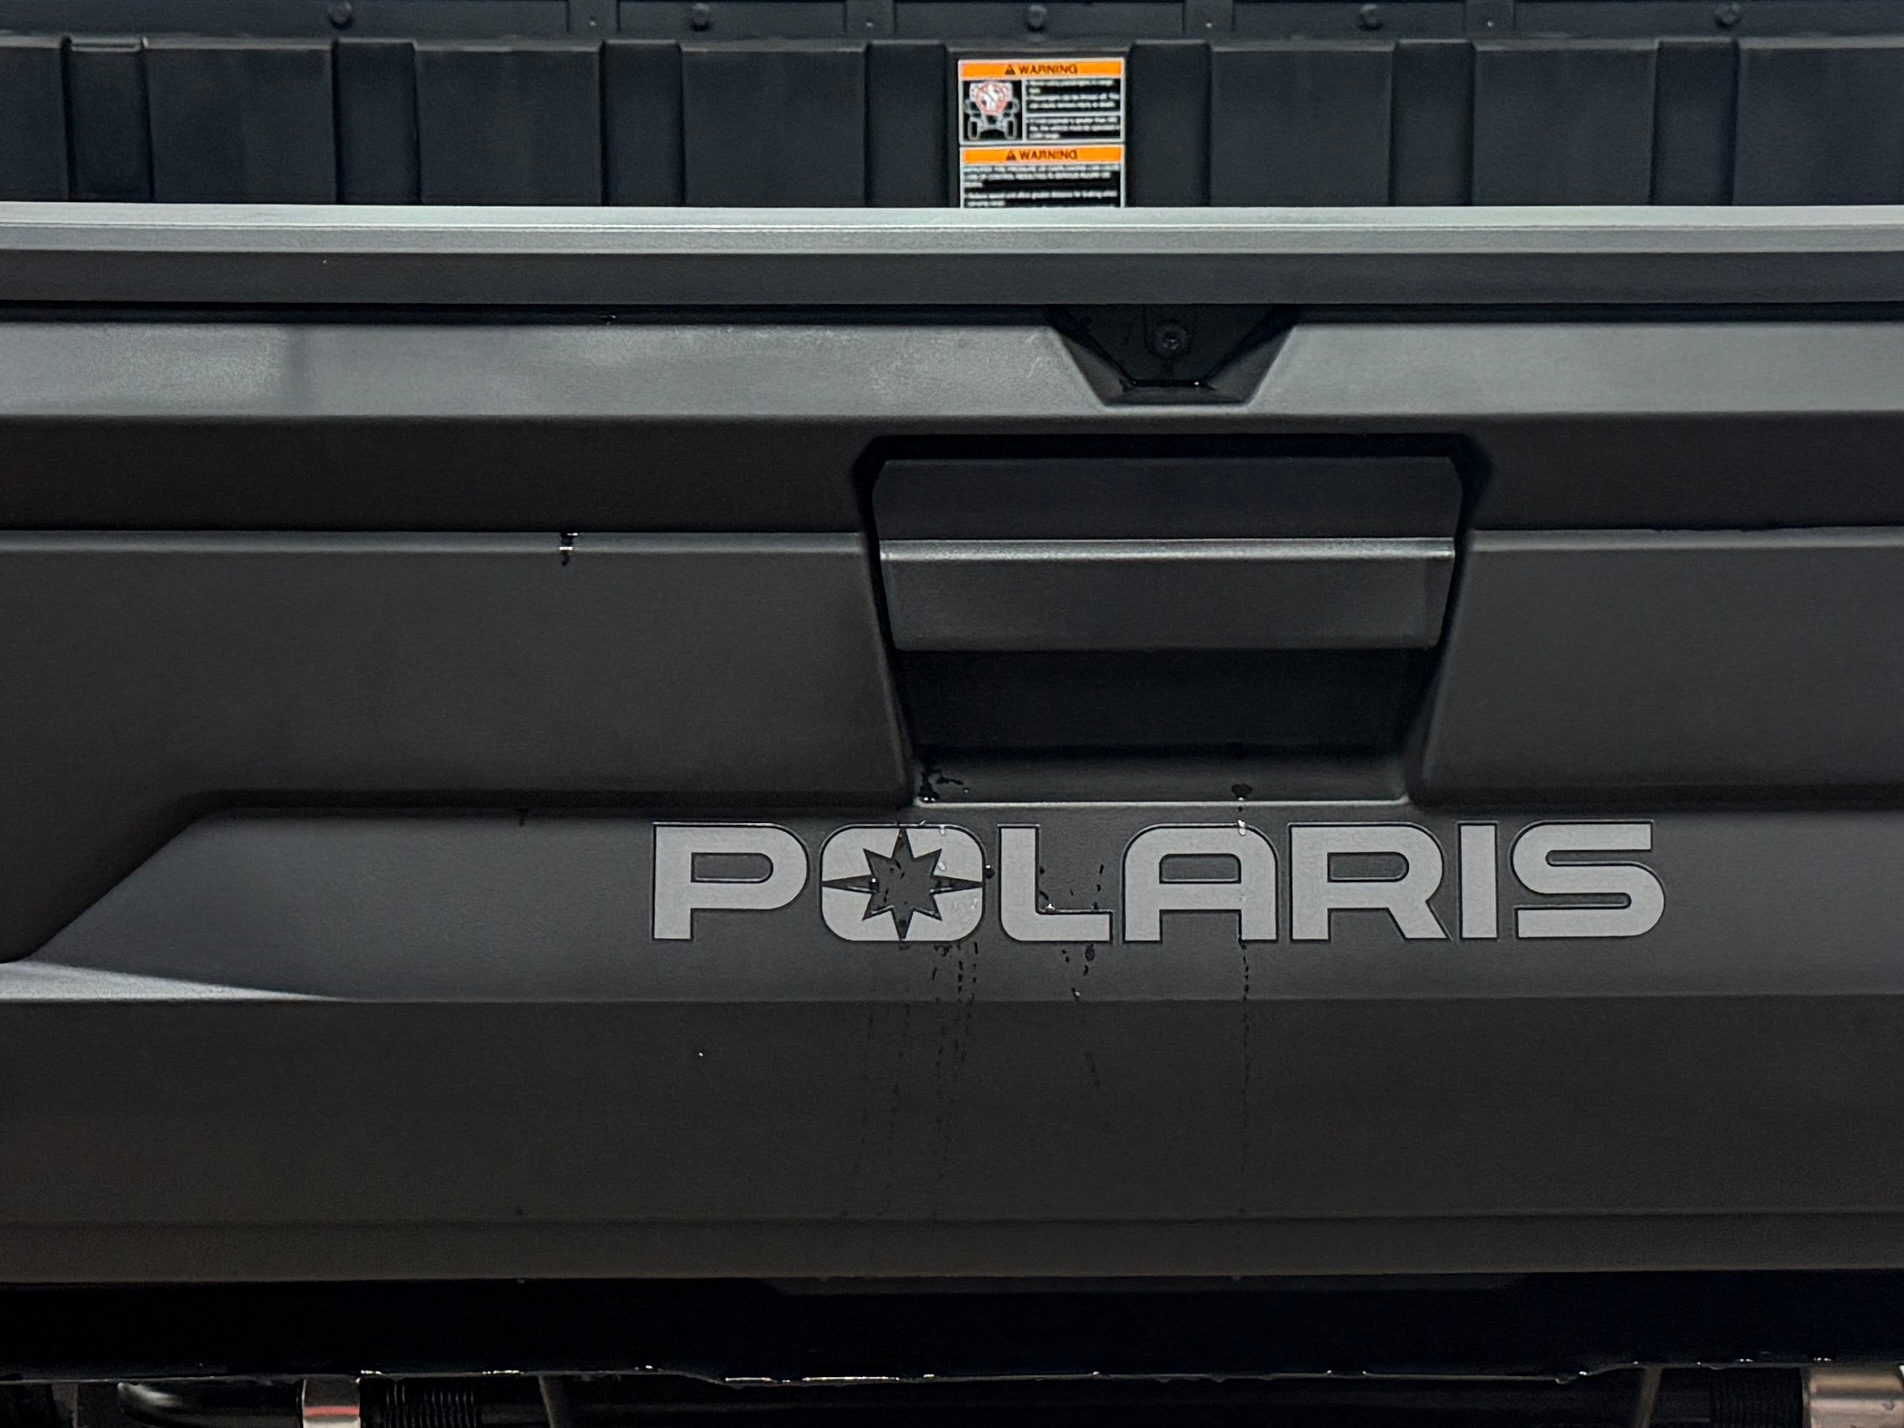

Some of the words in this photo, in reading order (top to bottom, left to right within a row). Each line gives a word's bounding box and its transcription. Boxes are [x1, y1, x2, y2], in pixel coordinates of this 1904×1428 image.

[1018, 63, 1078, 75] WARNING
[1019, 149, 1078, 161] WARNING
[652, 821, 1665, 941] POLARIS
